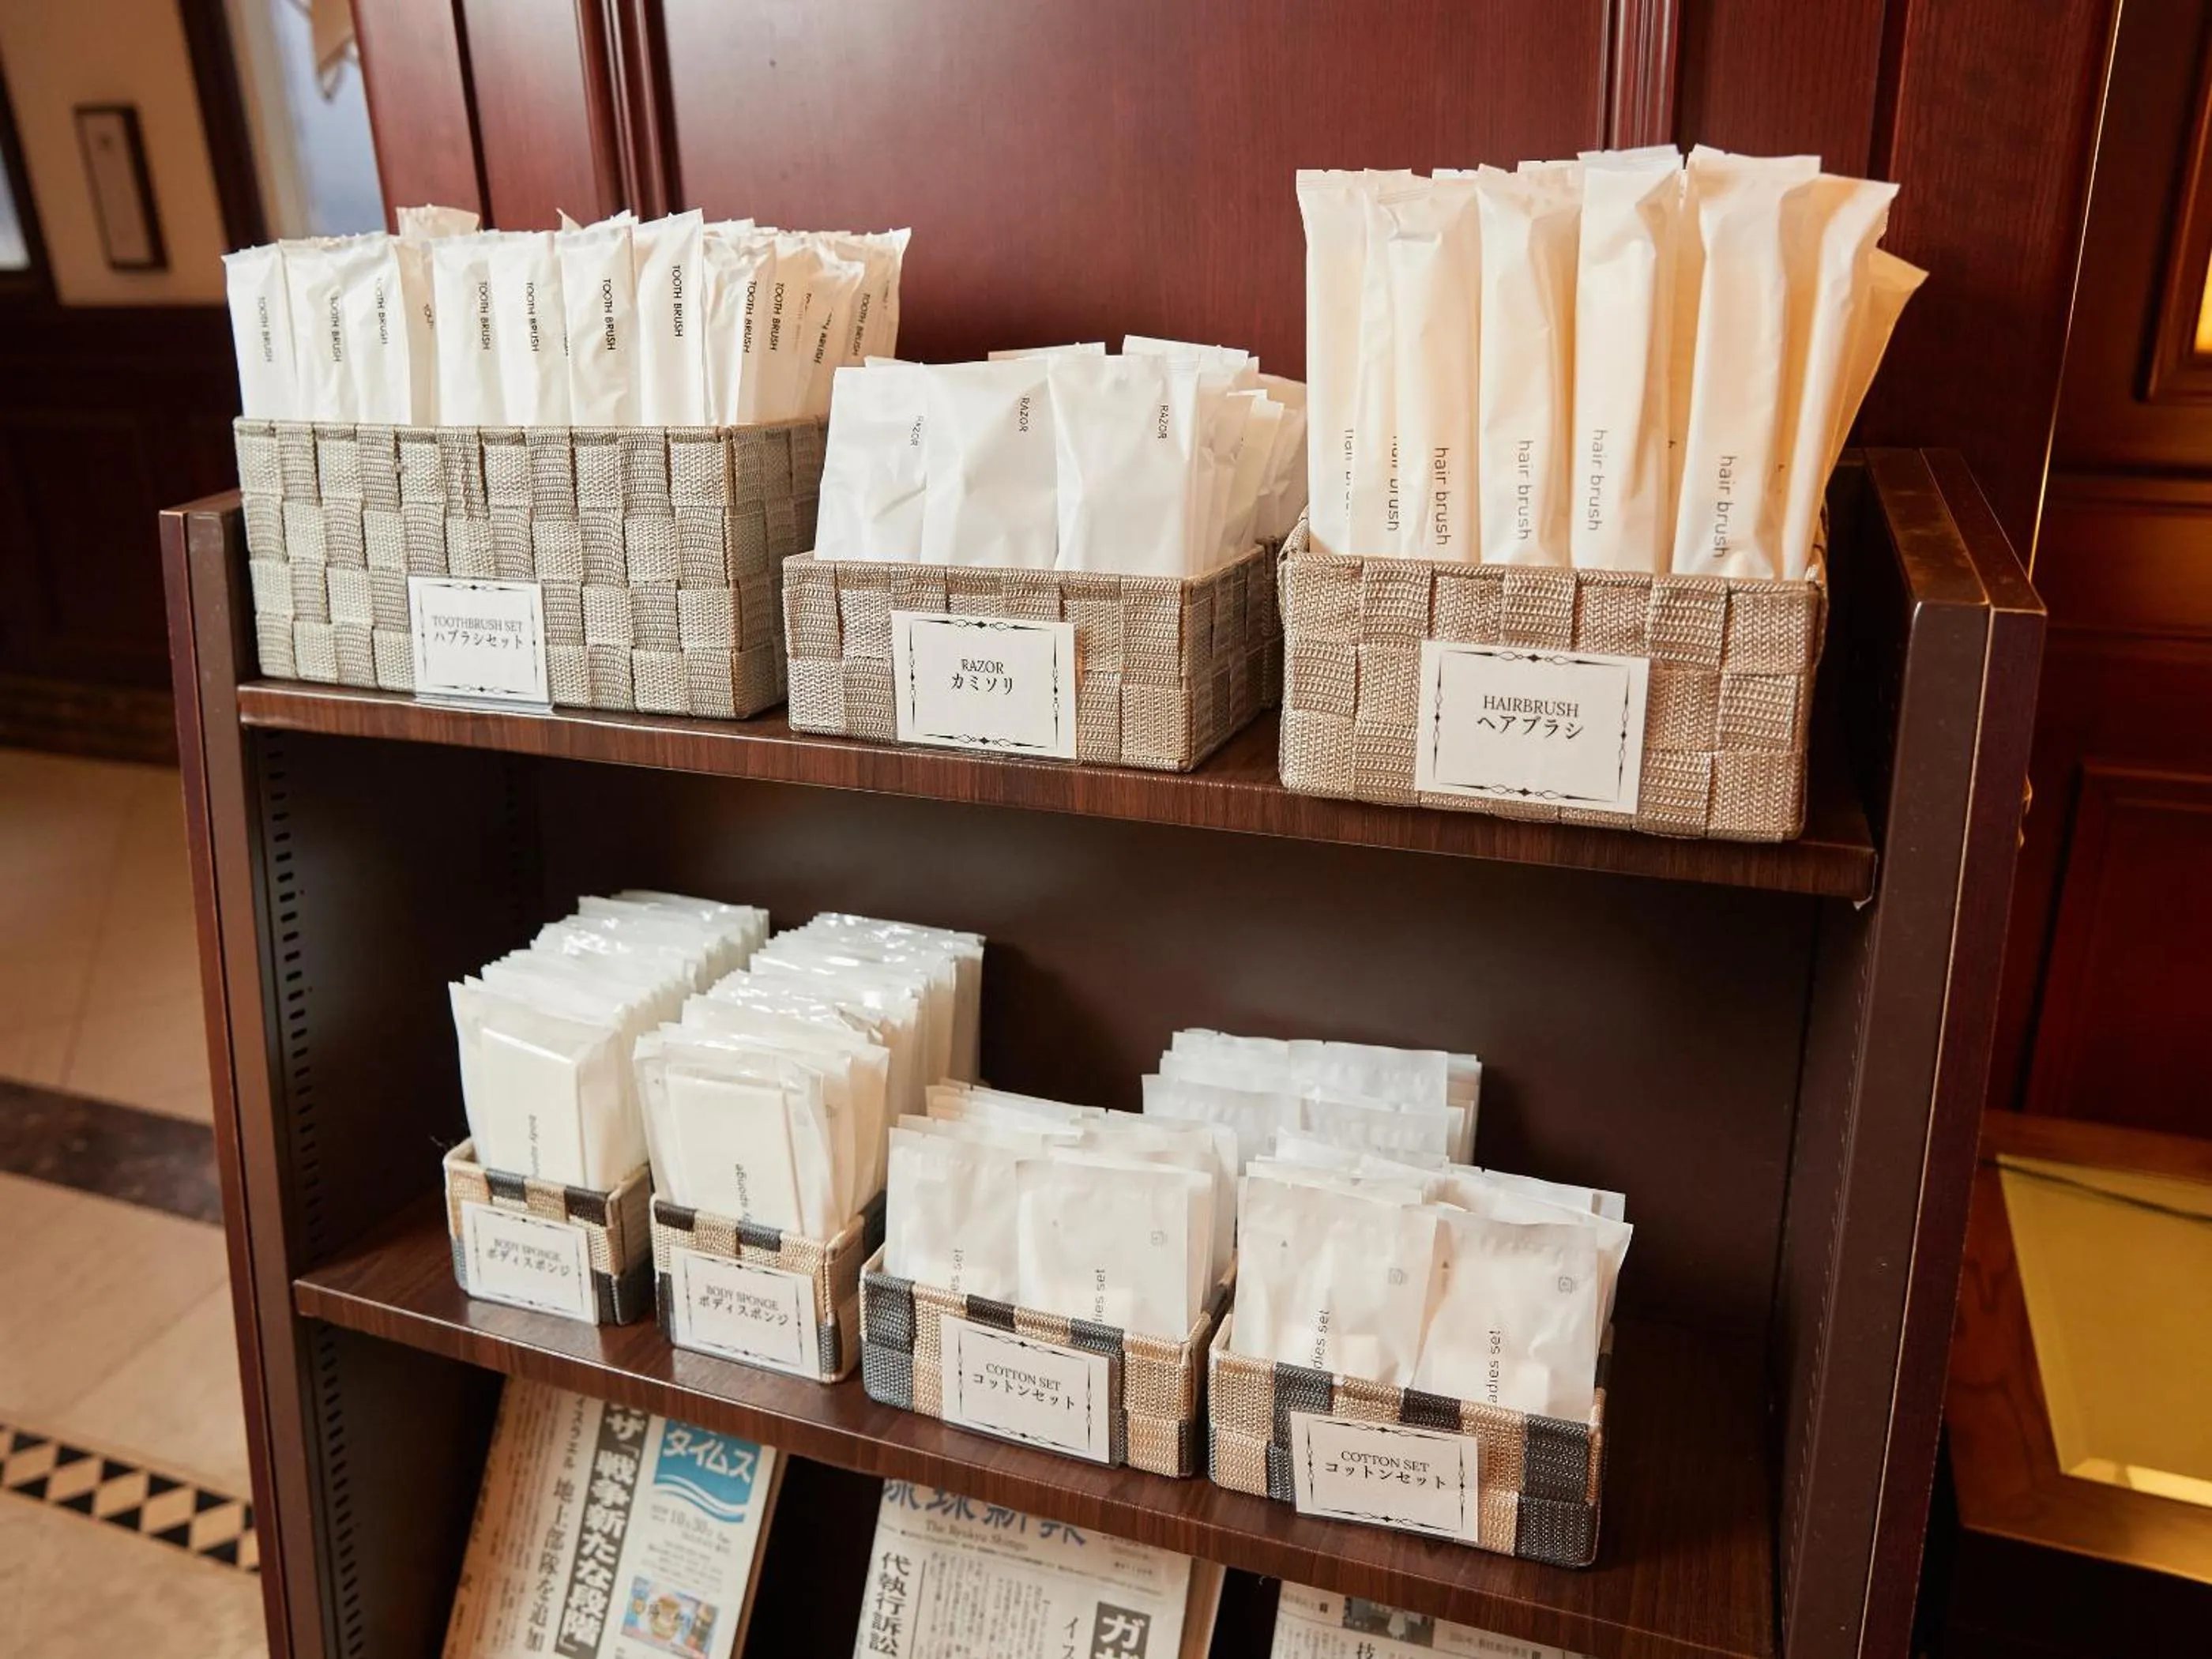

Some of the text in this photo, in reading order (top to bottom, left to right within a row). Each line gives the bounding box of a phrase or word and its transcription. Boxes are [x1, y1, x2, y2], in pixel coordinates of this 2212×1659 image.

[478, 280, 491, 350] TOOTH BRUSH
[525, 282, 536, 315] TOOTH
[602, 278, 616, 350] TOOTH BRUSH
[671, 265, 684, 337] TOOTH BRUSH
[743, 280, 758, 353] TOOTH BRUSH
[769, 283, 785, 351] TOOTH BRUSH
[331, 330, 342, 363] BRUSH
[1018, 397, 1030, 433] RAZOR
[1157, 404, 1169, 439] RAZOR
[1434, 447, 1453, 546] hair brush
[1518, 439, 1534, 540] hair brush
[1587, 428, 1608, 532] hair brush
[1712, 455, 1738, 559] hair brush
[431, 615, 524, 633] TOOTHBRUSH SET
[433, 630, 525, 650] ハブラシセット
[950, 672, 1014, 695] カミソリ
[960, 658, 1005, 675] RAZOR
[1482, 694, 1580, 718] HAIRBRUSH
[1477, 714, 1585, 739] ヘアブラシ
[1094, 1267, 1106, 1292] set
[1311, 1309, 1330, 1370] dies set
[985, 1362, 1061, 1392] COTTON SET
[1485, 1330, 1501, 1404] adies set
[972, 1372, 1075, 1411] コットンセット
[662, 1427, 755, 1483] タイムス
[1341, 1450, 1430, 1473] COTTON SET
[1325, 1462, 1446, 1490] コットンセット
